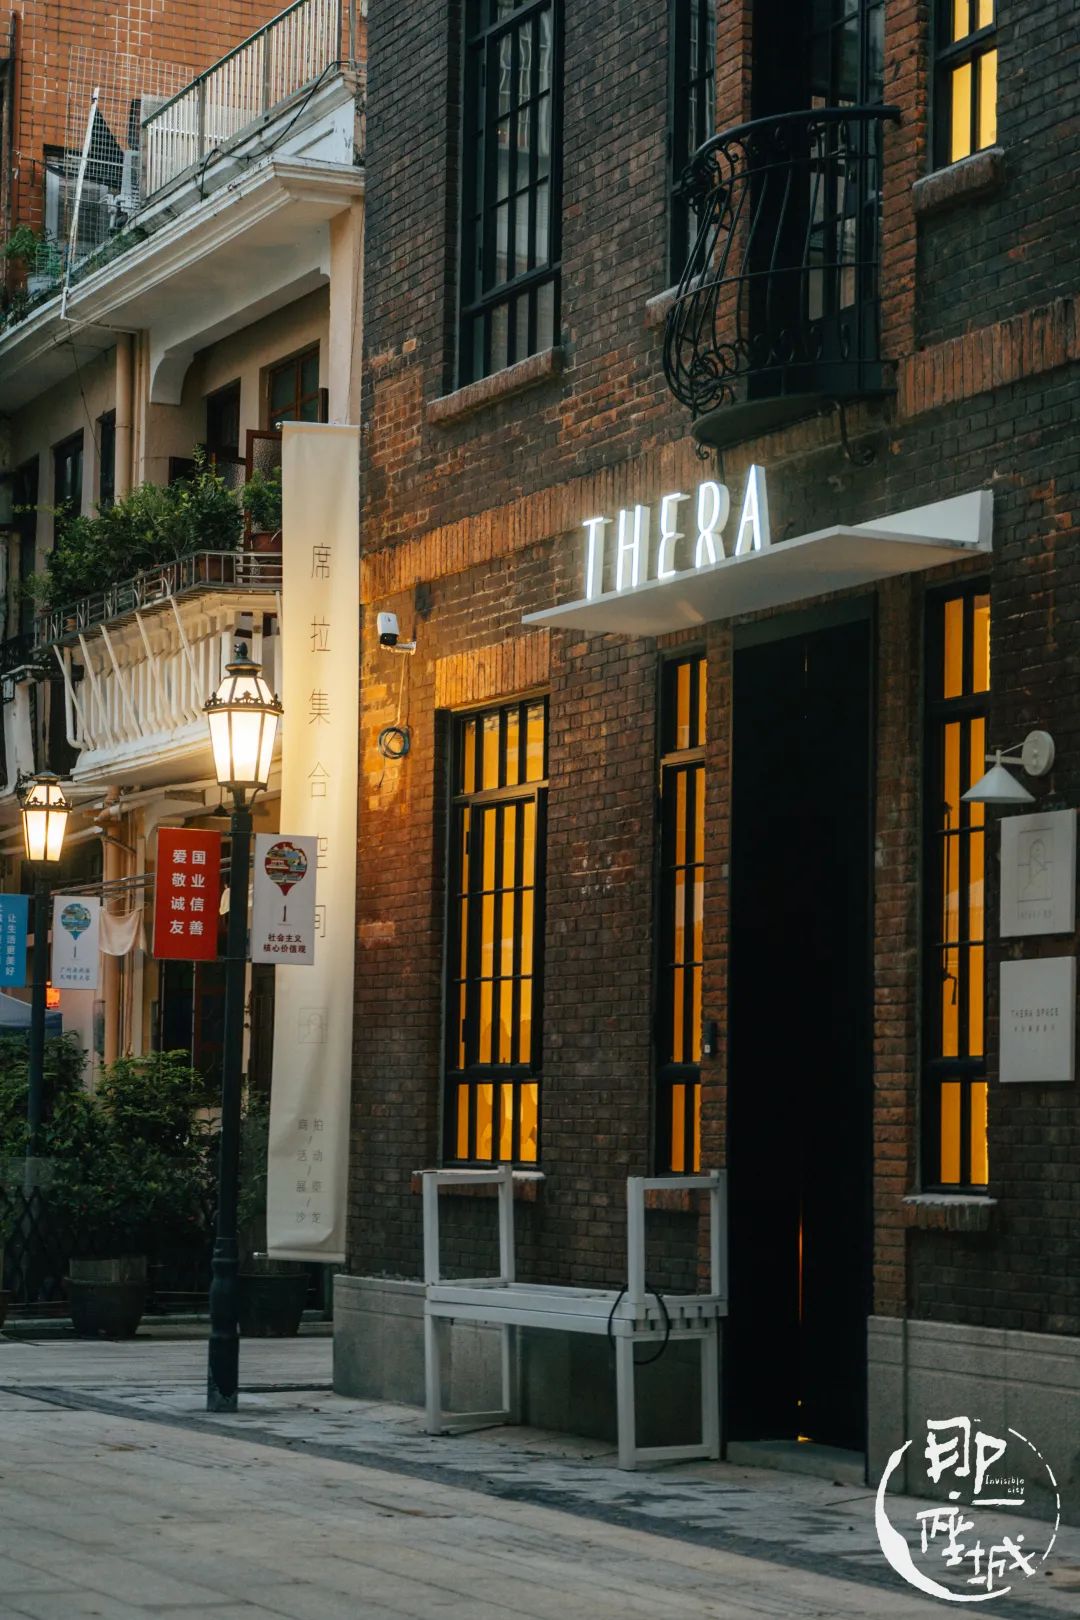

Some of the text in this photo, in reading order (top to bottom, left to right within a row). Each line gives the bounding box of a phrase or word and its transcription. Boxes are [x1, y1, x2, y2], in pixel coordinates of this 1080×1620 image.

[582, 464, 772, 600] THERA
[172, 849, 206, 865] 爱国
[171, 872, 205, 888] 敬业
[170, 896, 204, 912] 诚信
[169, 920, 204, 935] 友善
[268, 933, 302, 943] 社会主义
[263, 944, 306, 954] 核心价值观
